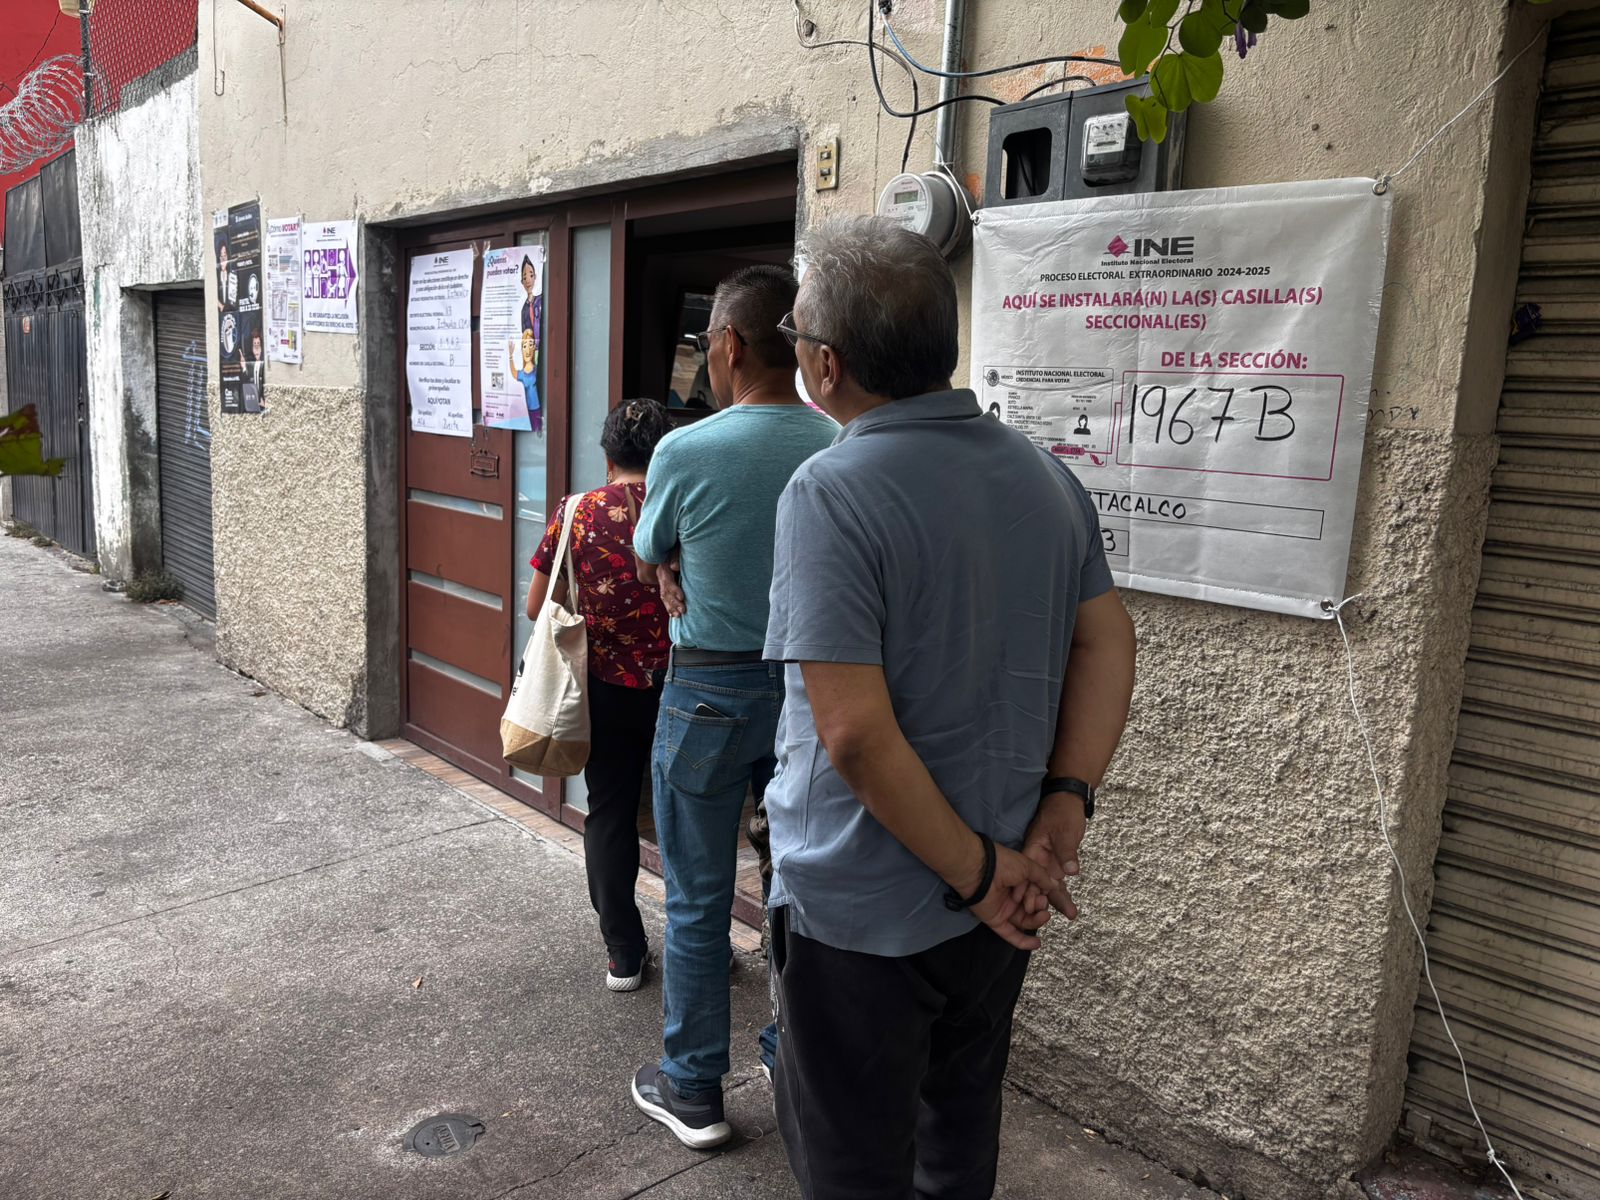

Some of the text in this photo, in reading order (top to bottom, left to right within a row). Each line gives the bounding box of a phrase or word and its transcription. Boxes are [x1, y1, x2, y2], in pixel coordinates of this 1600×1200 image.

[1134, 237, 1194, 256] INE
[487, 265, 519, 279] pueden votar?
[1040, 267, 1270, 282] PROCESO ELECTORAL EXTRAORDINARIO 2024-2025
[1003, 287, 1323, 310] AQUÍ SE INSTALARÁ(N) LA(S) CASILLA(S)
[1086, 314, 1207, 331] SECCIONAL(ES)
[1161, 350, 1307, 369] DE LA SECCIÓN:
[1129, 384, 1296, 446] 1967 B
[1086, 491, 1186, 519] TACALCO
